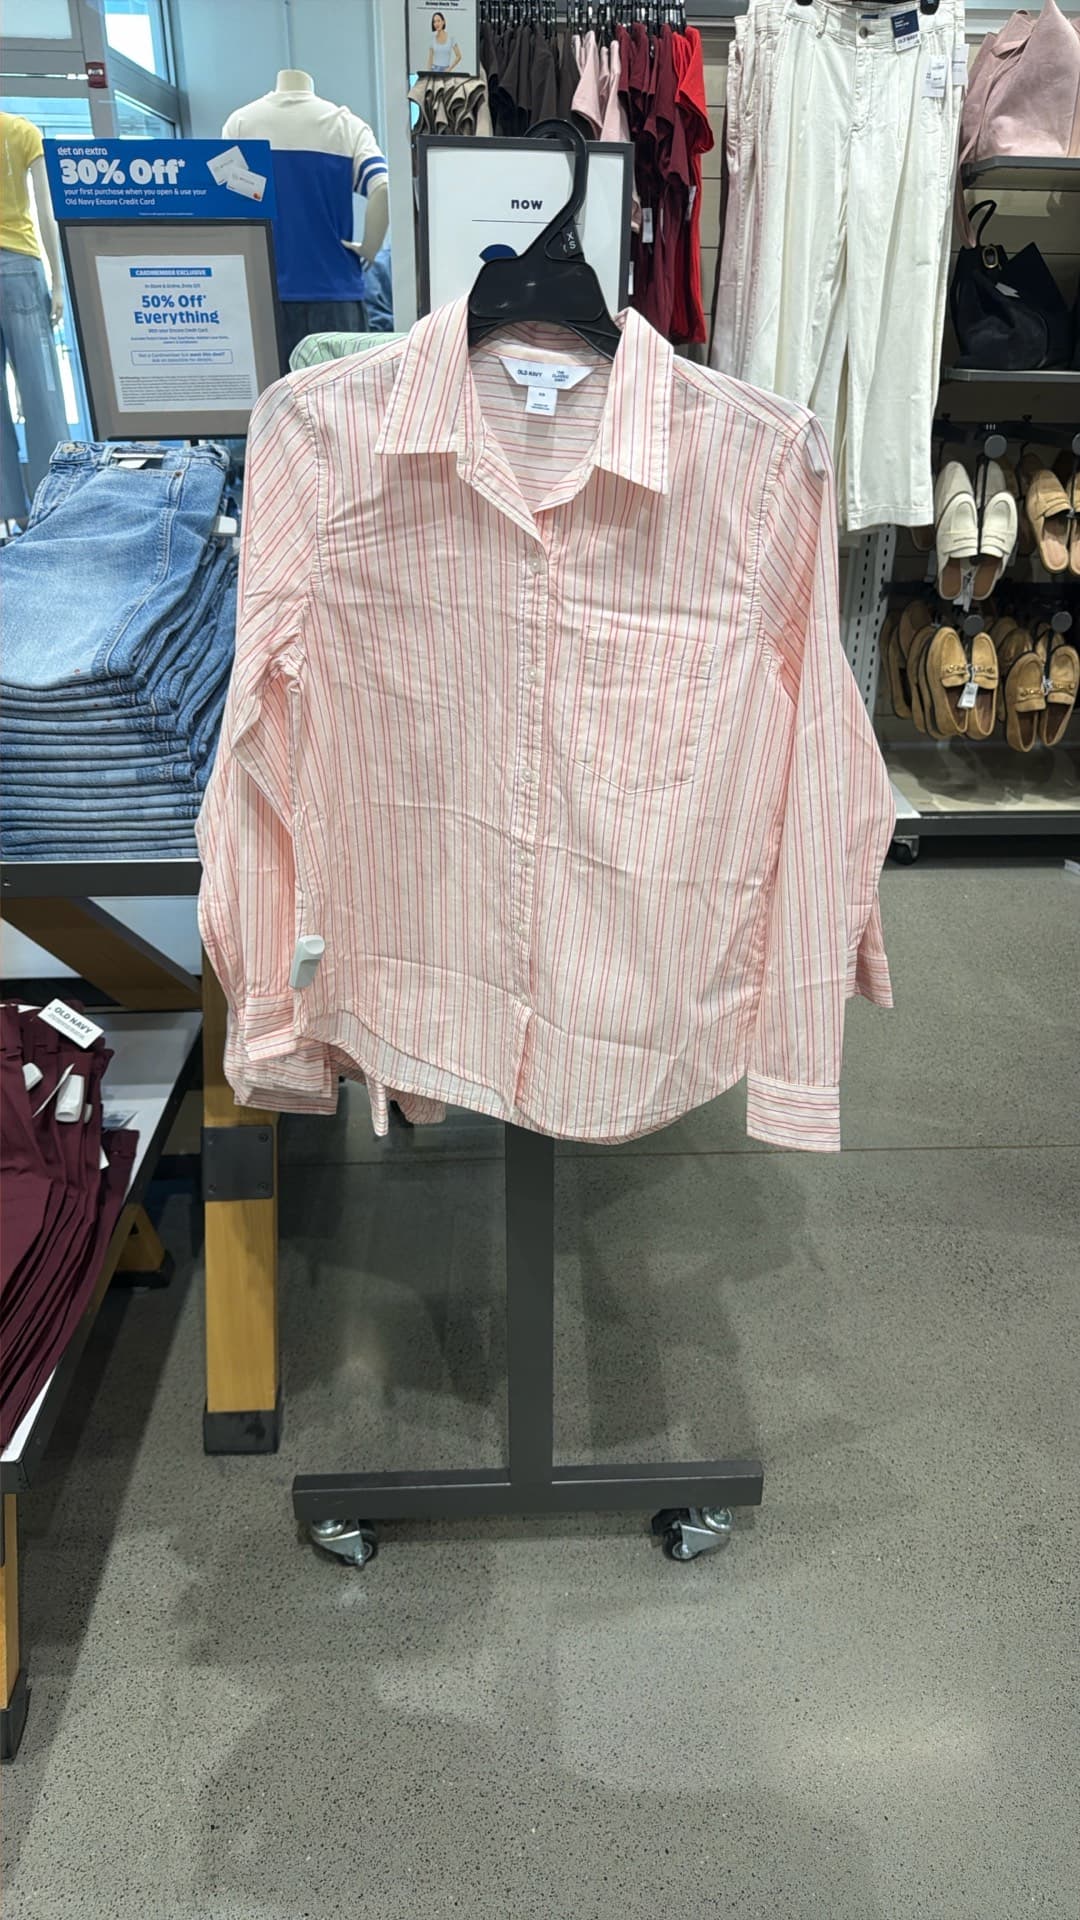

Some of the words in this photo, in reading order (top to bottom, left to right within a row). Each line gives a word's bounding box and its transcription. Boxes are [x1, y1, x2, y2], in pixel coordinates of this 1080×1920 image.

[57, 147, 71, 156] get
[85, 148, 108, 156] extra
[59, 158, 126, 185] 30%
[94, 188, 124, 196] purchase
[65, 198, 78, 206] Old
[78, 198, 94, 206] Navy
[96, 198, 118, 206] Encore
[119, 198, 138, 206] Credit
[139, 198, 155, 206] Card
[511, 199, 543, 210] now
[566, 231, 576, 250] XS
[142, 295, 174, 308] 50%
[134, 310, 220, 325] Everything
[54, 1007, 71, 1020] OLD
[68, 1017, 93, 1034] NAVY
